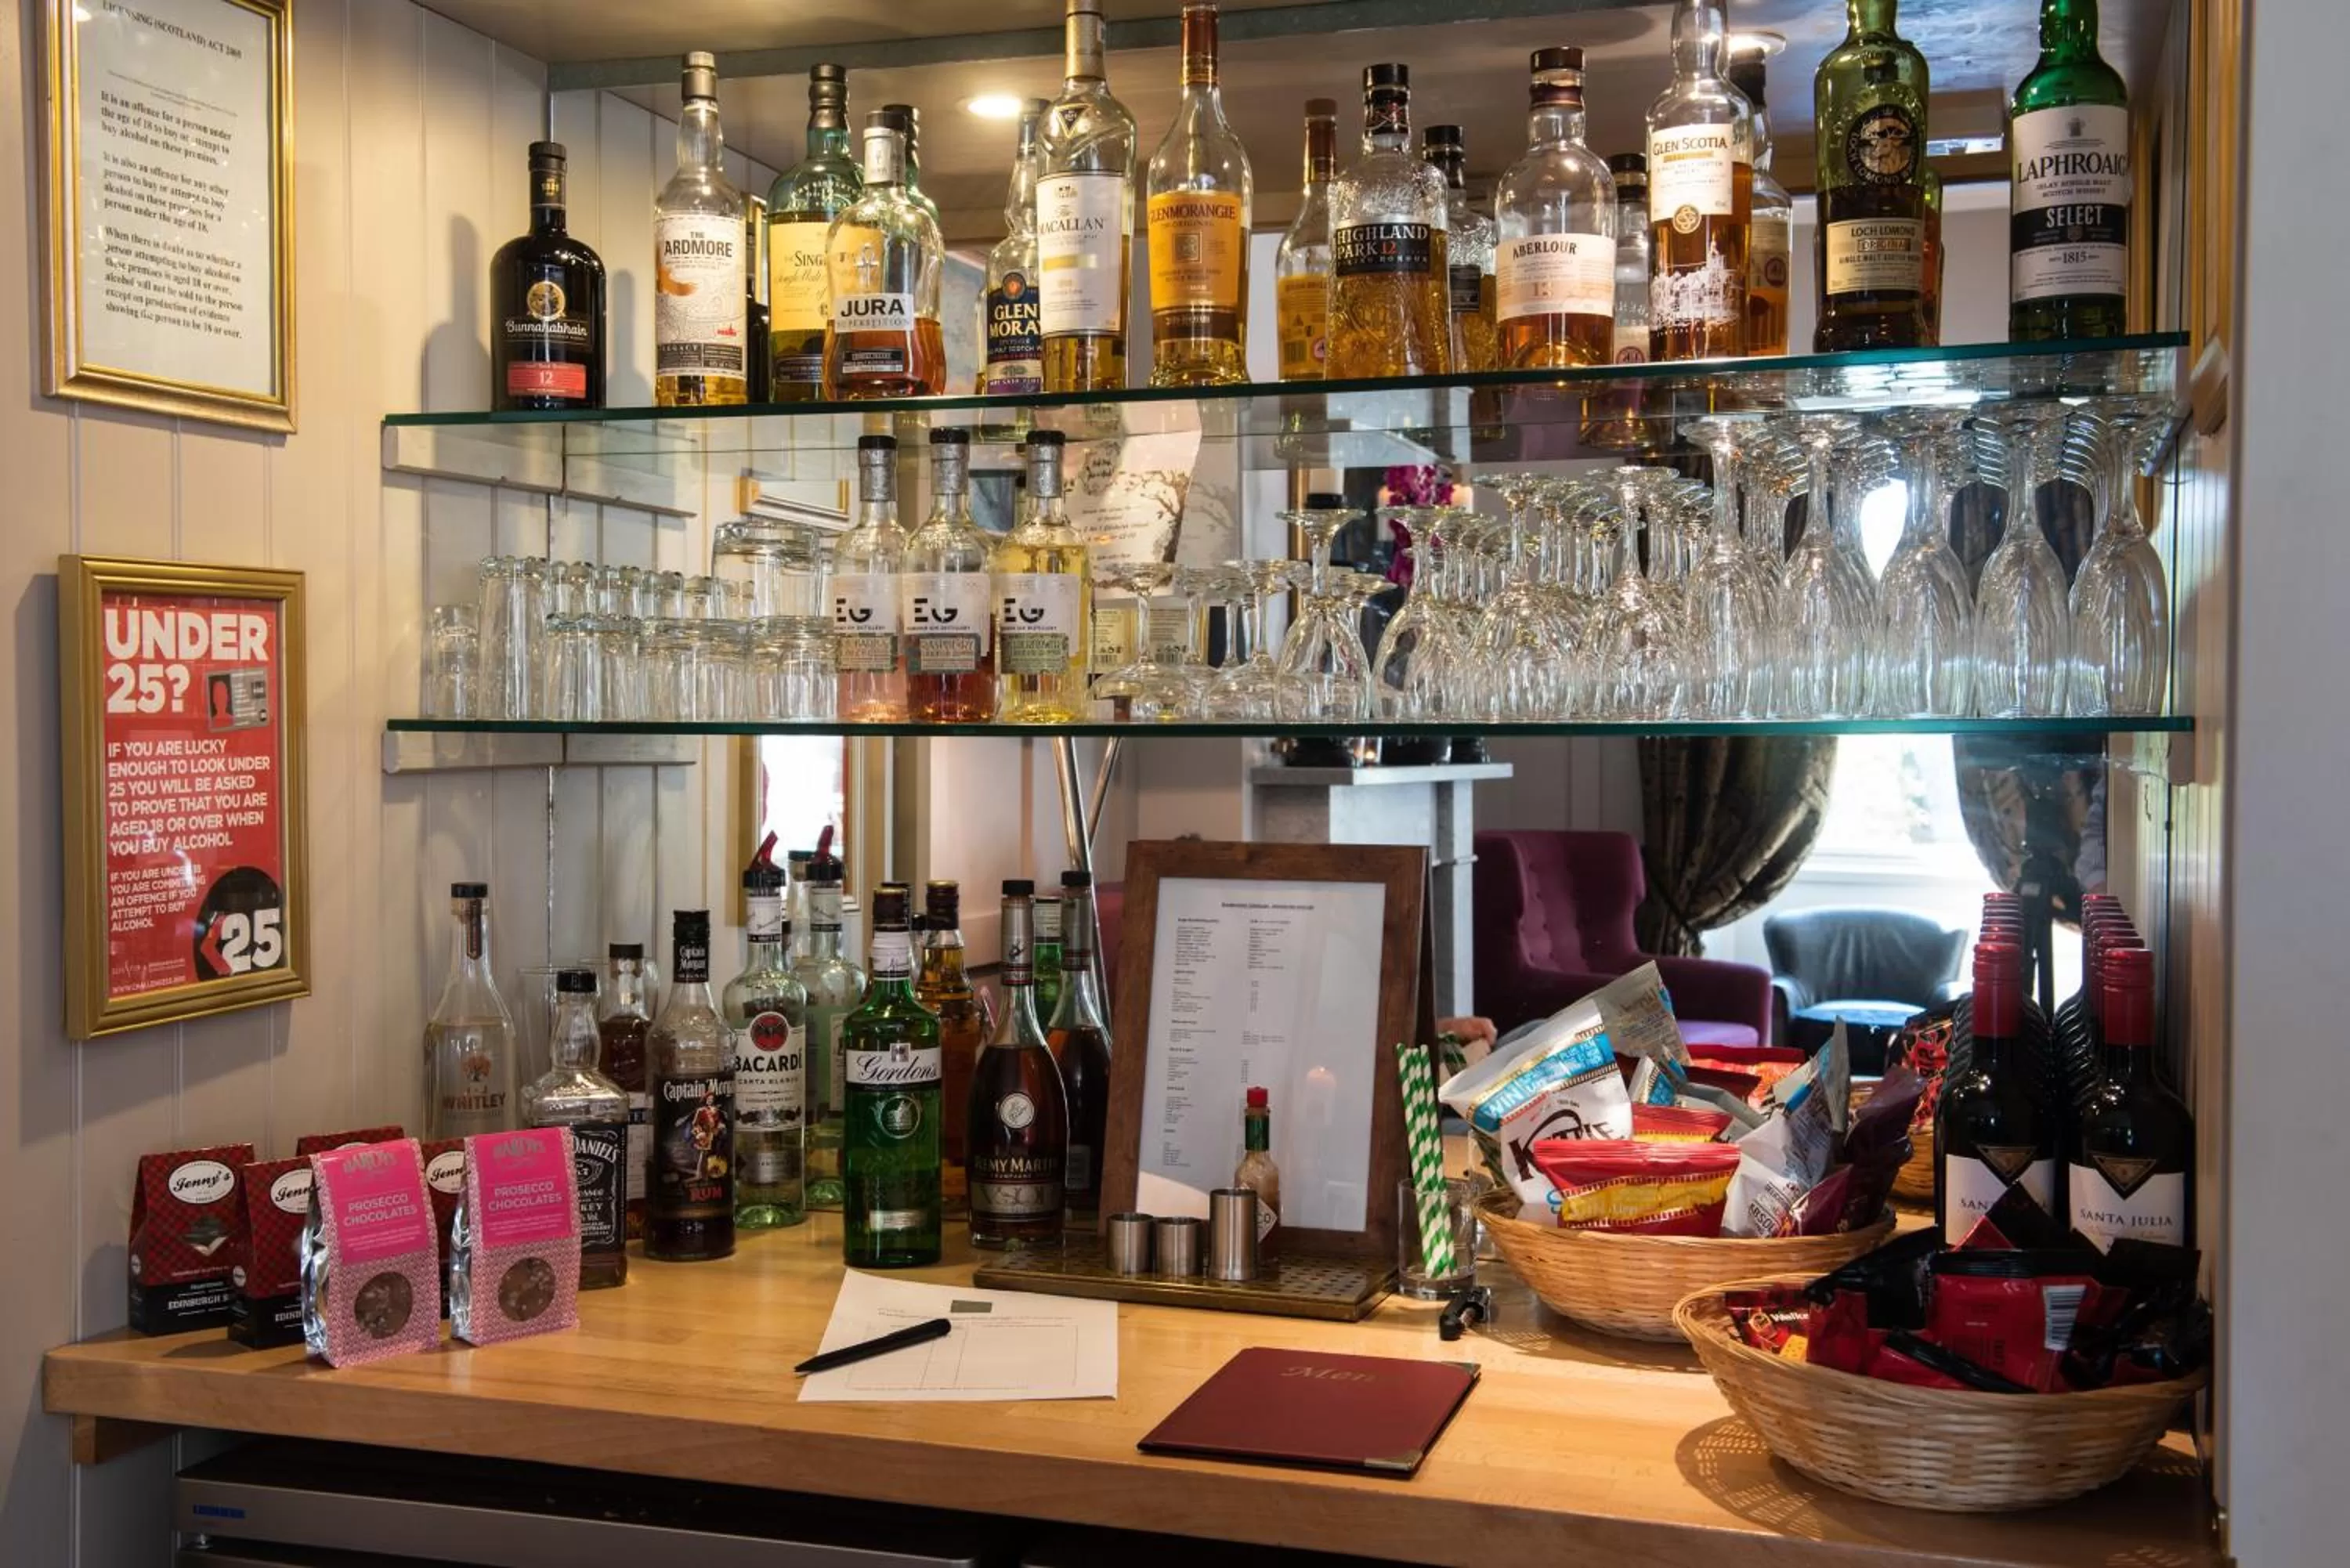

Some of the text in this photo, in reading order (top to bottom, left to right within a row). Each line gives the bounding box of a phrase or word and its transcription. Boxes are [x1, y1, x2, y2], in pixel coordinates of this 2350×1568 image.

[1653, 140, 1679, 156] GLEN
[2046, 205, 2103, 228] SELECT
[1337, 225, 1428, 244] HIGHLAND
[1851, 225, 1915, 237] LOCH LOMOND
[664, 239, 732, 258] ARDMORE
[1337, 240, 1399, 259] PARK 12
[1513, 240, 1577, 260] ABERLOUR
[2063, 251, 2087, 264] 1815
[841, 298, 905, 317] JURA
[994, 303, 1039, 320] GLEN
[539, 370, 553, 385] 12
[104, 609, 269, 661] UNDER
[107, 663, 190, 714] 25?
[108, 739, 227, 757] IF YOU ARE LUCKY
[108, 756, 270, 777] ENOUGH TO LOOK UNDER
[109, 775, 255, 797] 25 YOU WILL BE ASKED
[109, 793, 267, 817] TO PROVE THAT YOU ARE
[110, 811, 264, 837] AGED 18 OR OVER WHEN
[110, 832, 233, 857] YOU BUY ALCOHOL
[110, 872, 120, 883] IF
[121, 871, 140, 881] YOU
[141, 868, 161, 879] ARE
[110, 883, 131, 895] YOU
[132, 882, 150, 892] ARE
[110, 888, 198, 909] AN OFFENCE IF YOU
[110, 901, 186, 920] ATTEMPT TO BUY
[110, 917, 154, 932] ALCOHOL
[856, 1054, 937, 1082] Gordon's
[663, 1079, 707, 1102] Captain
[1488, 1081, 1524, 1118] WIN
[173, 1170, 230, 1193] Jenny's
[495, 1181, 555, 1197] PROSECCO
[349, 1194, 408, 1213] PROSECCO
[489, 1194, 562, 1211] CHOCOLATES
[690, 1187, 722, 1201] RUM
[344, 1205, 418, 1227] CHOCOLATES
[2081, 1209, 2173, 1227] SANTA JULIA
[168, 1296, 220, 1310] EDINBURGH
[275, 1312, 302, 1323] EDINB
